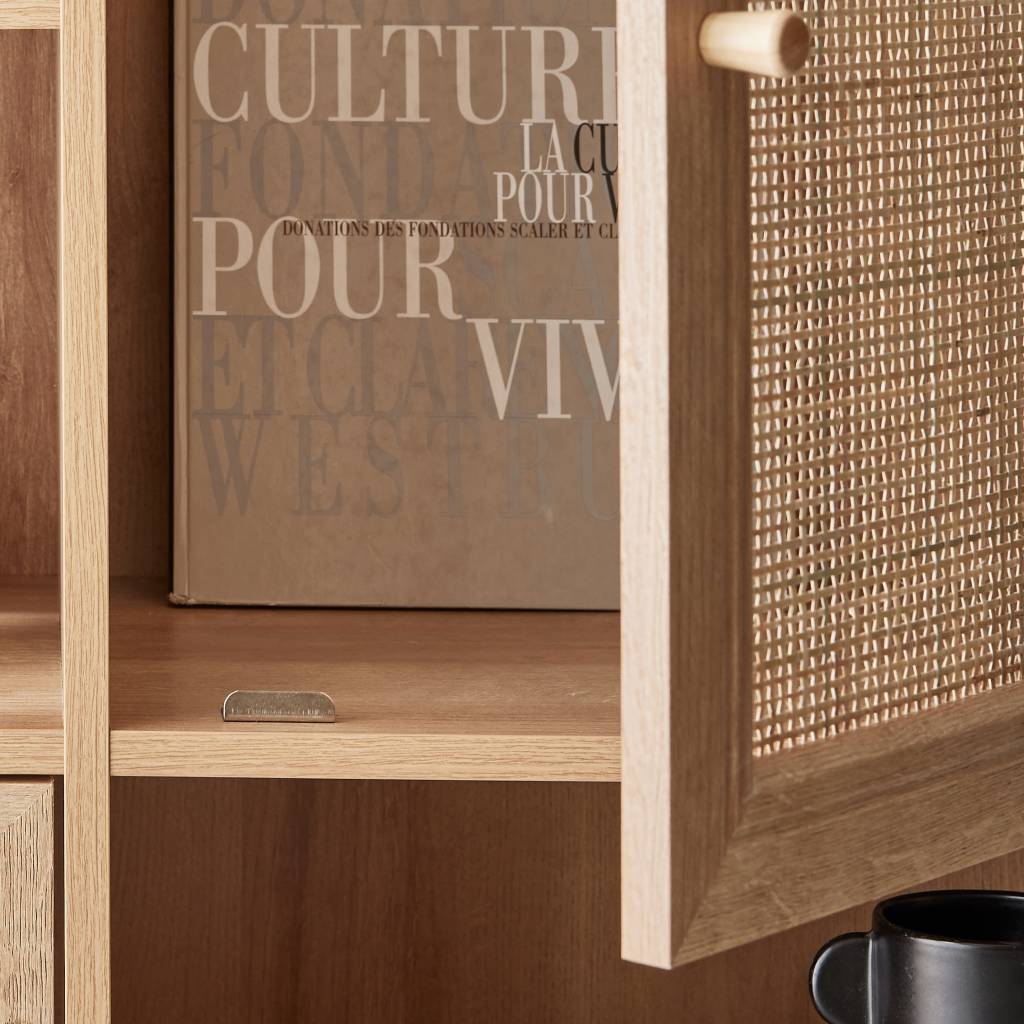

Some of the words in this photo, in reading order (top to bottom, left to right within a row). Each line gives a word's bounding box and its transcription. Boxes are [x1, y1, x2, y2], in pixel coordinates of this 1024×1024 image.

[519, 121, 568, 173] LA
[492, 171, 596, 224] POUR
[283, 219, 370, 237] DONATIONS
[375, 220, 404, 237] DES
[408, 221, 506, 238] FONDATIONS
[509, 222, 569, 239] SCALER
[574, 223, 596, 239] ET
[191, 216, 463, 319] POUR
